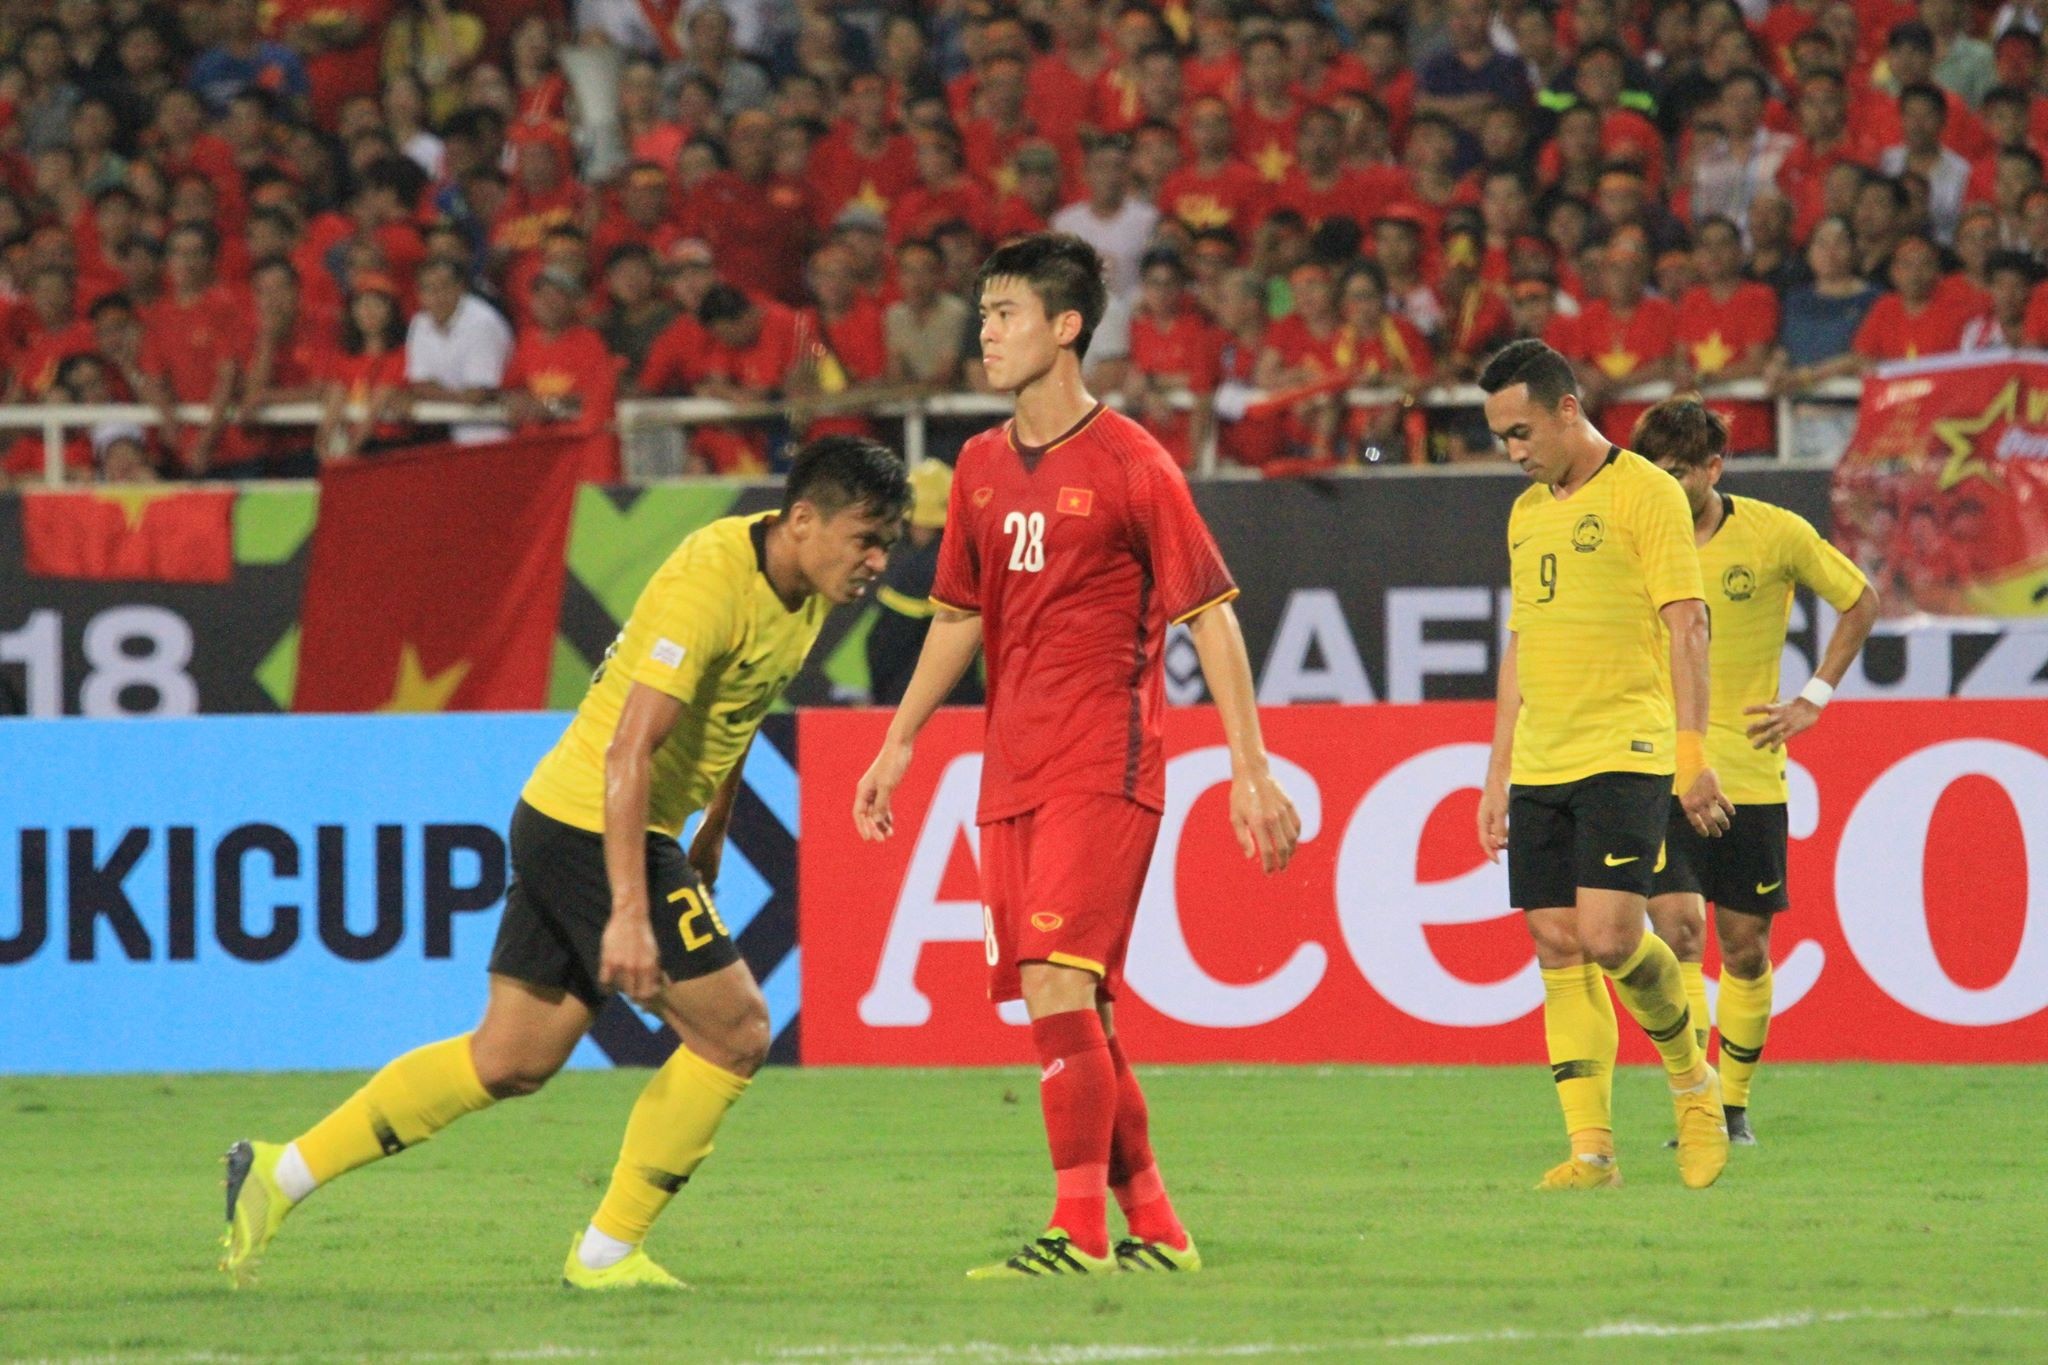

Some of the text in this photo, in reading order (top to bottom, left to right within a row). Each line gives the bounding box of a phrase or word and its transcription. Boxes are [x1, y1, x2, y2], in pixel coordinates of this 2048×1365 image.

[1003, 511, 1045, 573] 28
[1536, 553, 1558, 603] 9
[0, 603, 200, 719] 18
[1256, 586, 1514, 706] AF
